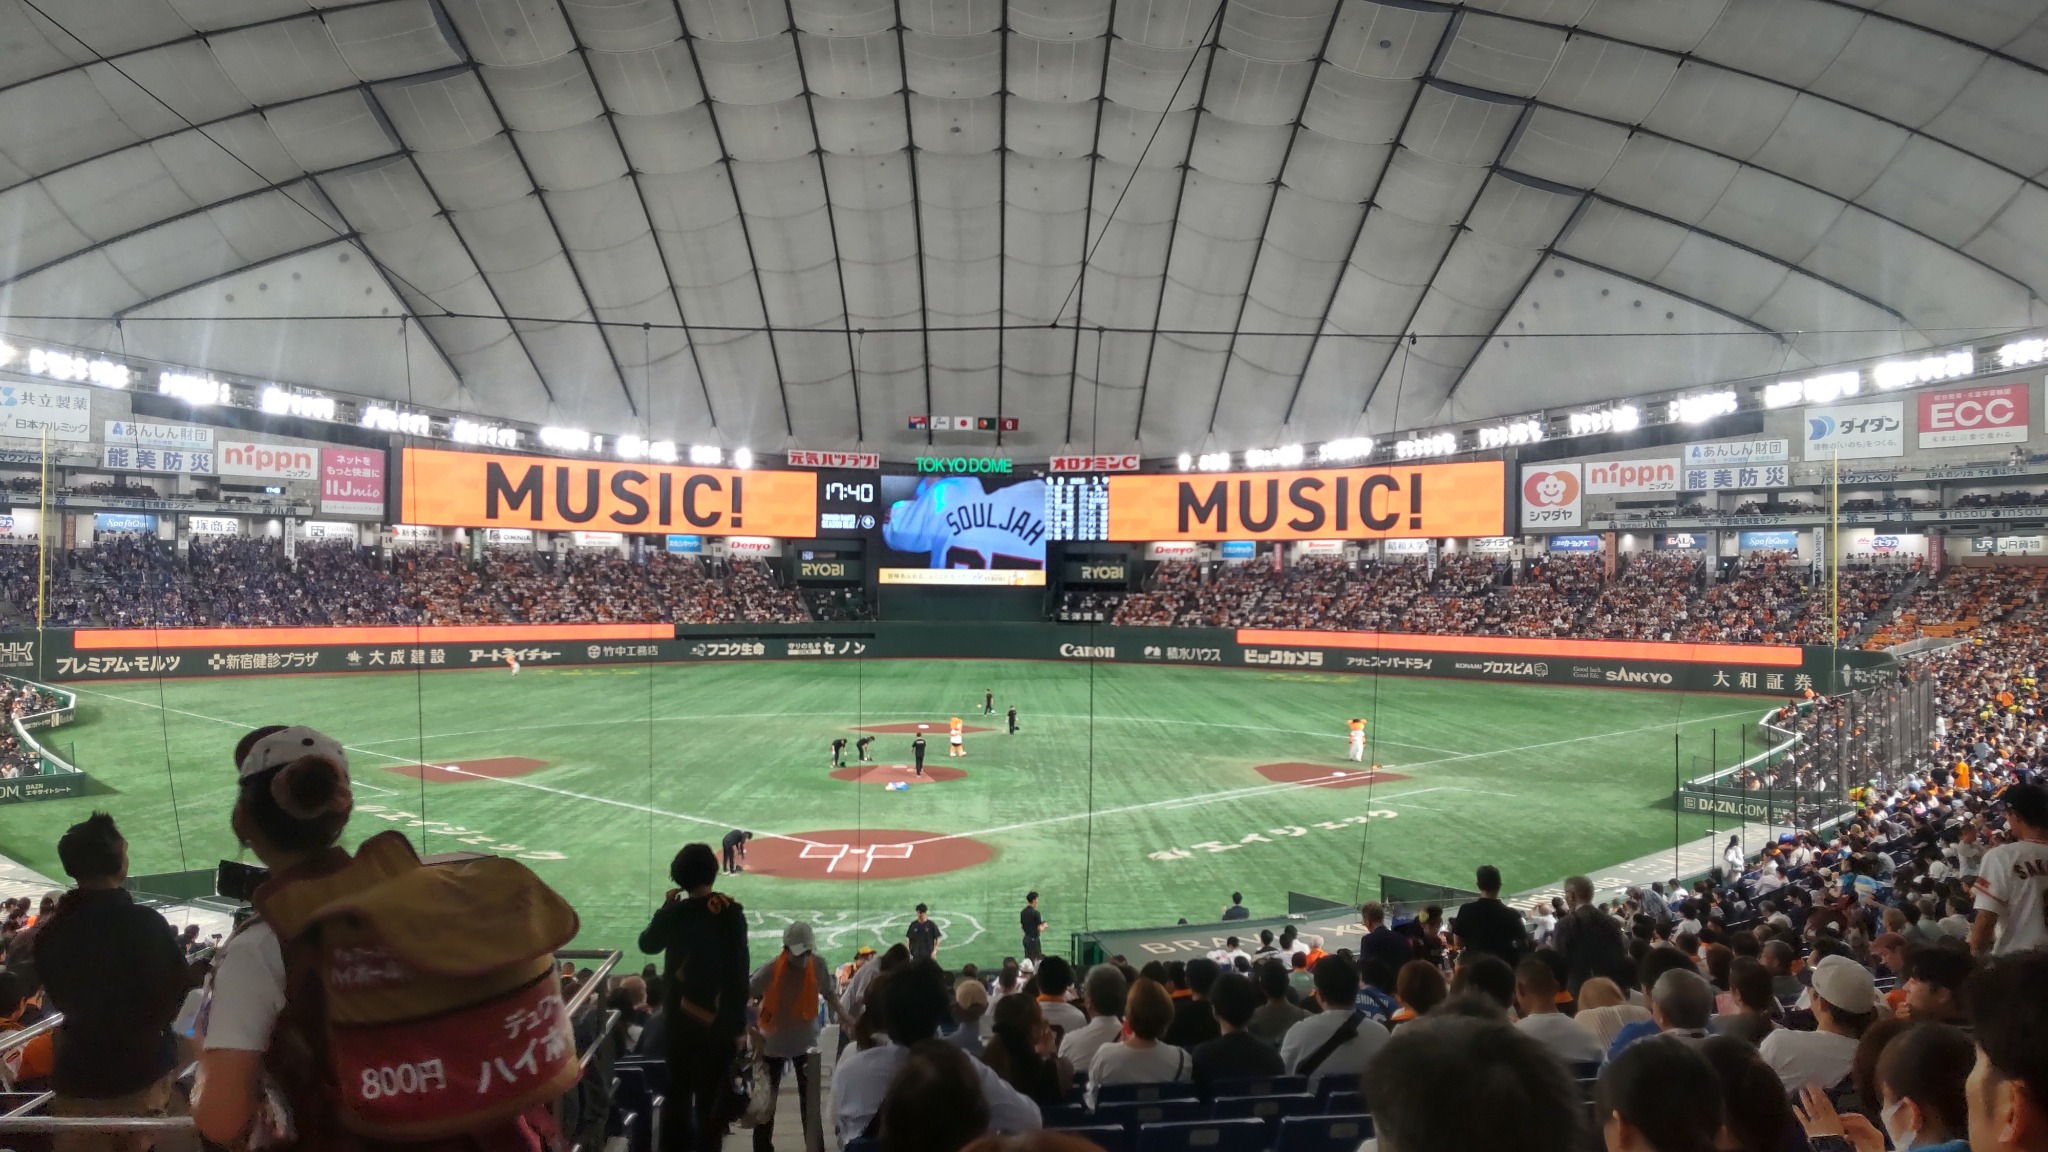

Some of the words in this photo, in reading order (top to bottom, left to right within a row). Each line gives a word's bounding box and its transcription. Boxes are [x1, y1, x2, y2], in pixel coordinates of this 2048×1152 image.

[21, 391, 88, 410] 共立製薬
[1931, 398, 2014, 428] ECC
[16, 419, 88, 433] 日本カルミック
[126, 424, 206, 441] あんしん財団
[1840, 416, 1899, 434] ダイダン
[1703, 441, 1782, 457] あんしん財団
[108, 448, 209, 472] 能美防災
[225, 445, 312, 472] nippn
[337, 455, 371, 466] ネットを
[790, 452, 878, 468] 元気ハツラツ!
[915, 457, 966, 473] TOKYO
[969, 457, 1013, 473] DOME
[1053, 456, 1137, 470] オロナミンC
[286, 470, 311, 478] ニップン
[327, 466, 380, 478] もっと快適に
[1591, 463, 1674, 487] nippn
[1688, 467, 1785, 489] 能美防災
[1821, 473, 1898, 484] パマウントベッド
[485, 460, 744, 528] MUSIC!
[826, 483, 873, 502] 17:40
[1649, 482, 1674, 490] ニップン
[1177, 472, 1423, 533] MUSIC!
[1529, 508, 1572, 521] シマダヤ
[188, 519, 237, 532] 塚商会
[946, 502, 1046, 546] SOULJAH
[731, 541, 771, 551] Denyo
[1155, 546, 1194, 555] Denyo
[1388, 540, 1426, 550] 昭和大学
[1976, 541, 1994, 549] JR
[2000, 540, 2040, 549] JR貨物
[802, 563, 845, 577] RYOBI
[1081, 566, 1124, 579] RYOBI
[0, 641, 34, 662] HK
[469, 647, 561, 663] アートネイチャー
[603, 646, 659, 656] 竹中工務店
[707, 642, 766, 656] フコク生命
[823, 641, 866, 655] セノン
[1060, 643, 1115, 658] Canon
[1166, 646, 1222, 662] 積水ハウス
[56, 655, 181, 675] プレミアム・モルツ
[226, 652, 319, 670] 新宿健診プラザ
[368, 648, 446, 666] 大成建設
[1243, 649, 1324, 666] ビックカメラ
[1573, 671, 1588, 679] Good
[1606, 666, 1672, 684] SANKYO
[1712, 670, 1813, 691] 大和証券
[25, 786, 71, 796] エキサイトシート
[1699, 798, 1768, 817] DAZN.COM
[360, 1057, 446, 1101] 800円
